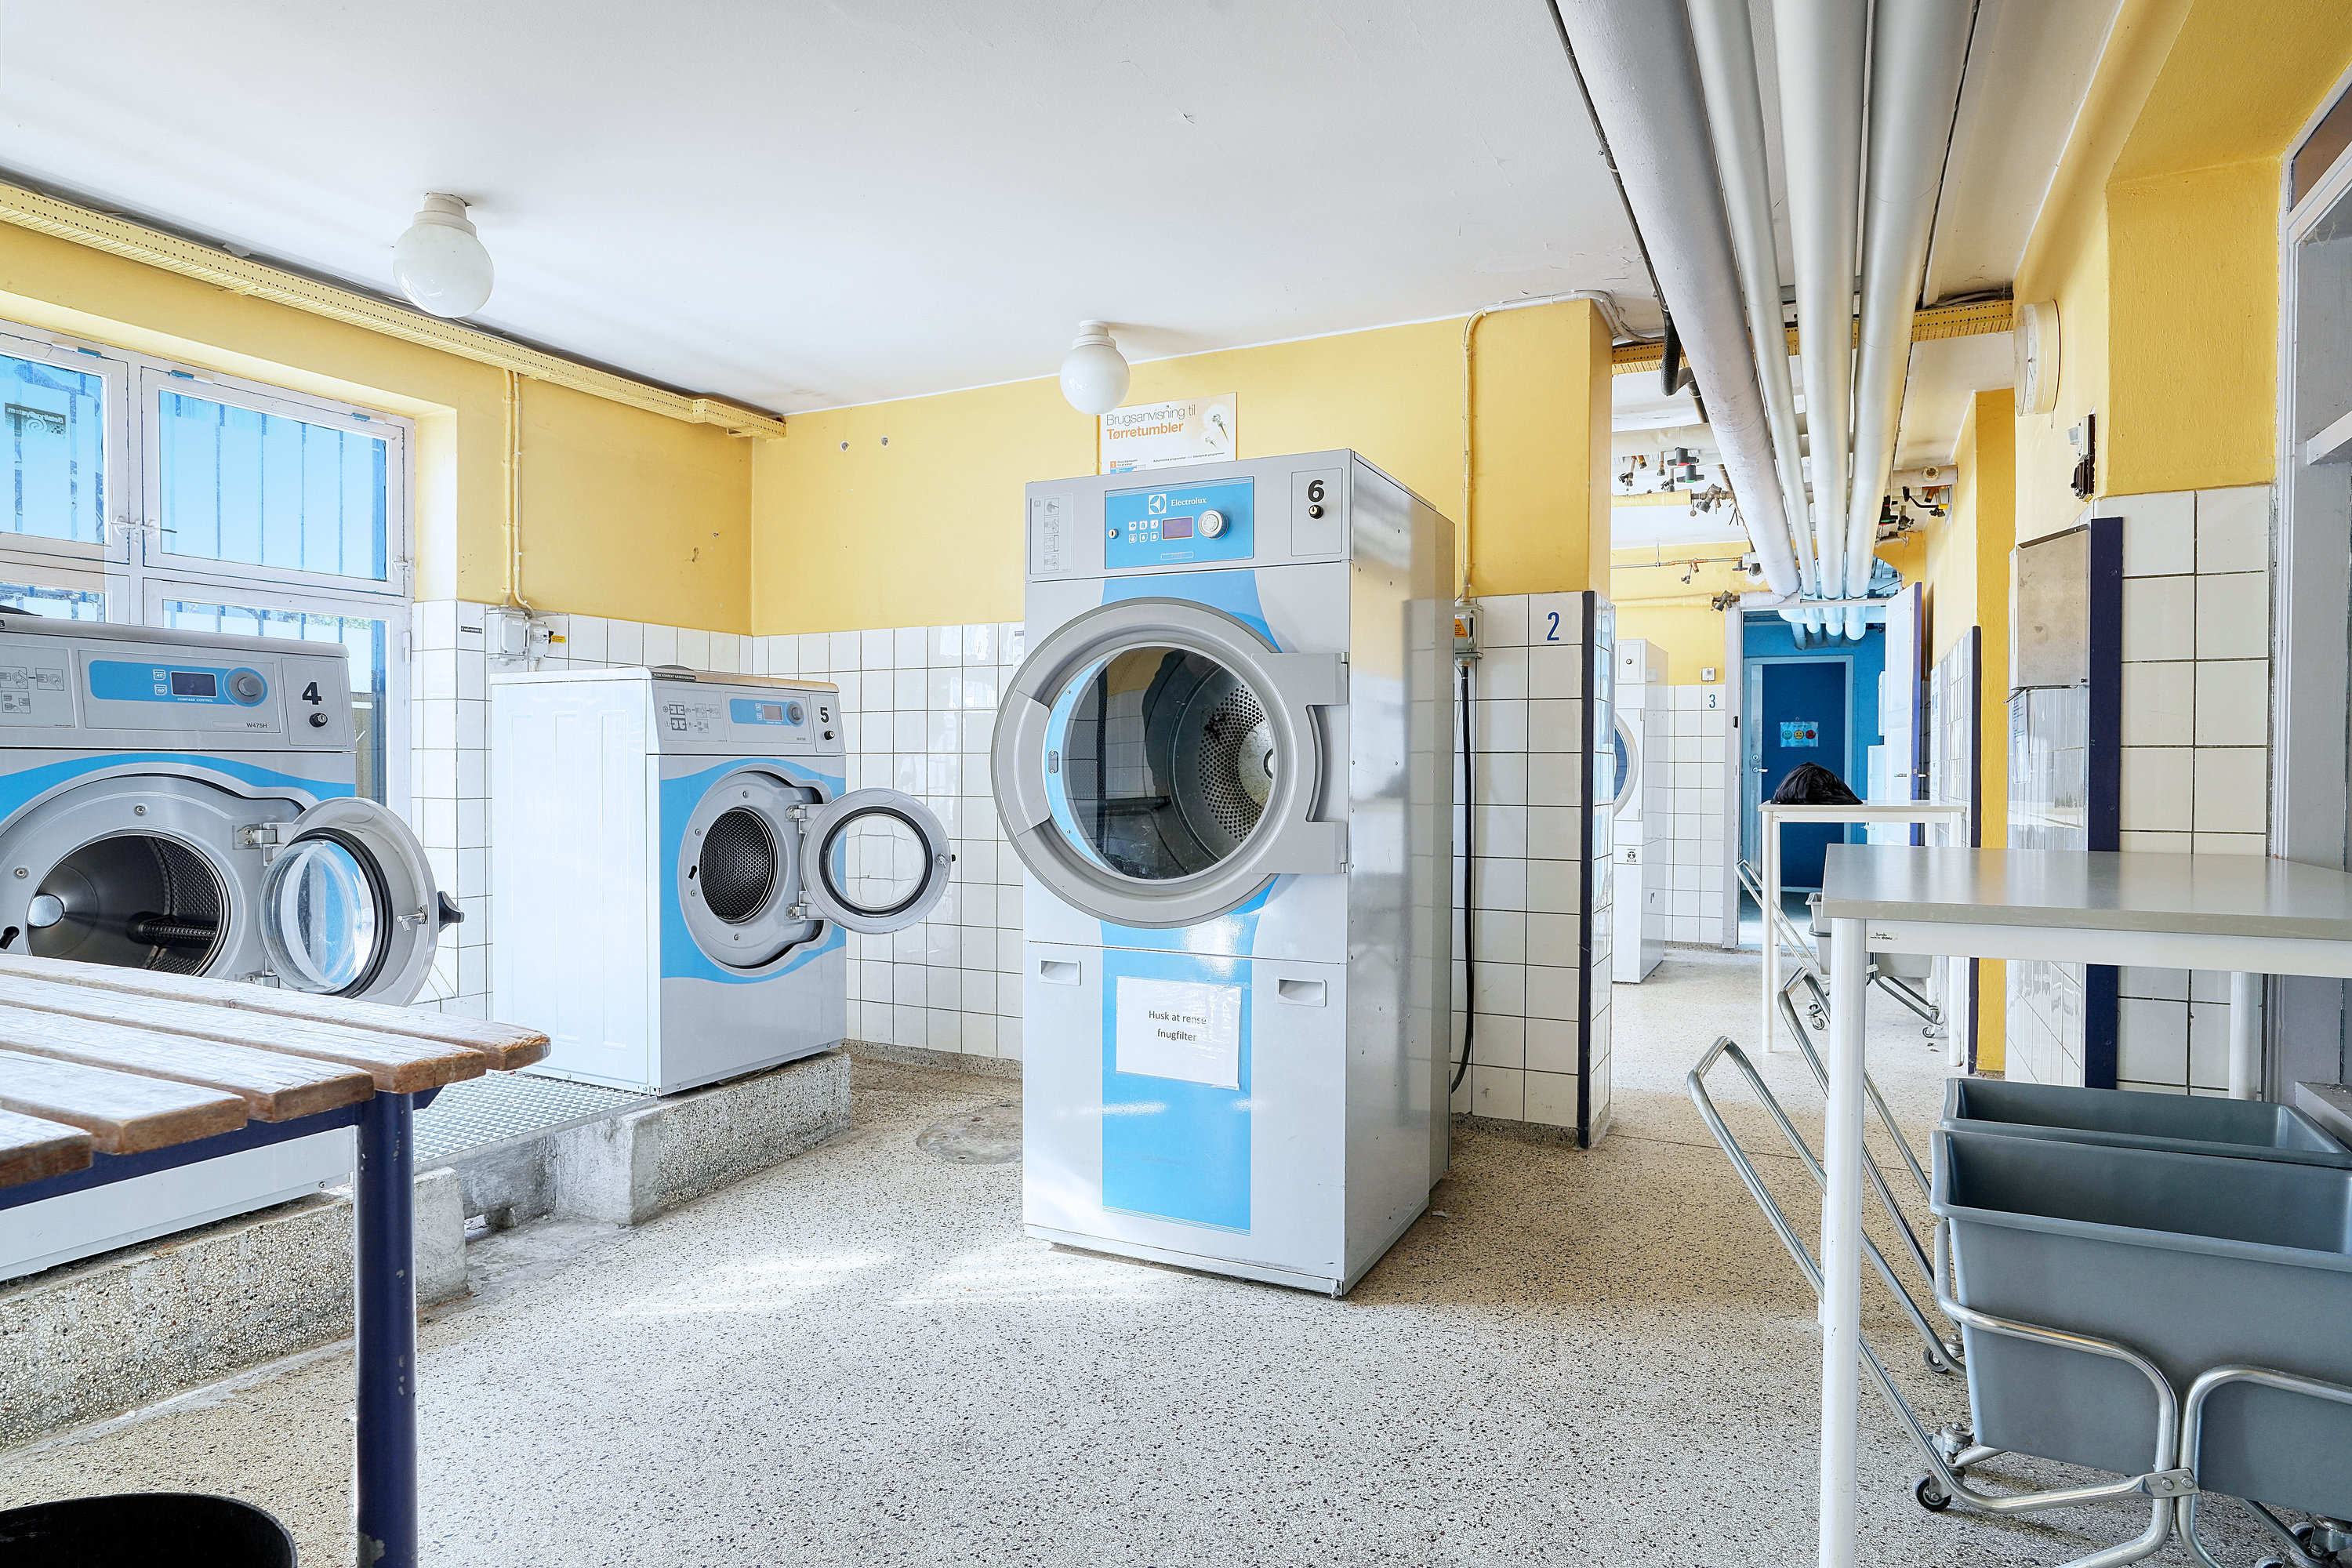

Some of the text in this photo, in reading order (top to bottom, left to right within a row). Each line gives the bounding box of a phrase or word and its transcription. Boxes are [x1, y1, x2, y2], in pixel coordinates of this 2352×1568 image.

[1106, 406, 1185, 426] Brugsanvisning
[1106, 422, 1184, 440] Tørretumbler
[1308, 479, 1325, 503] 6
[1171, 497, 1207, 506] Electrolux
[1547, 612, 1559, 641] 2
[302, 681, 322, 705] 4
[1709, 694, 1716, 708] 3
[820, 706, 829, 724] 5
[1149, 1010, 1207, 1025] Husk at rense
[1157, 1028, 1197, 1041] fnugfilter
